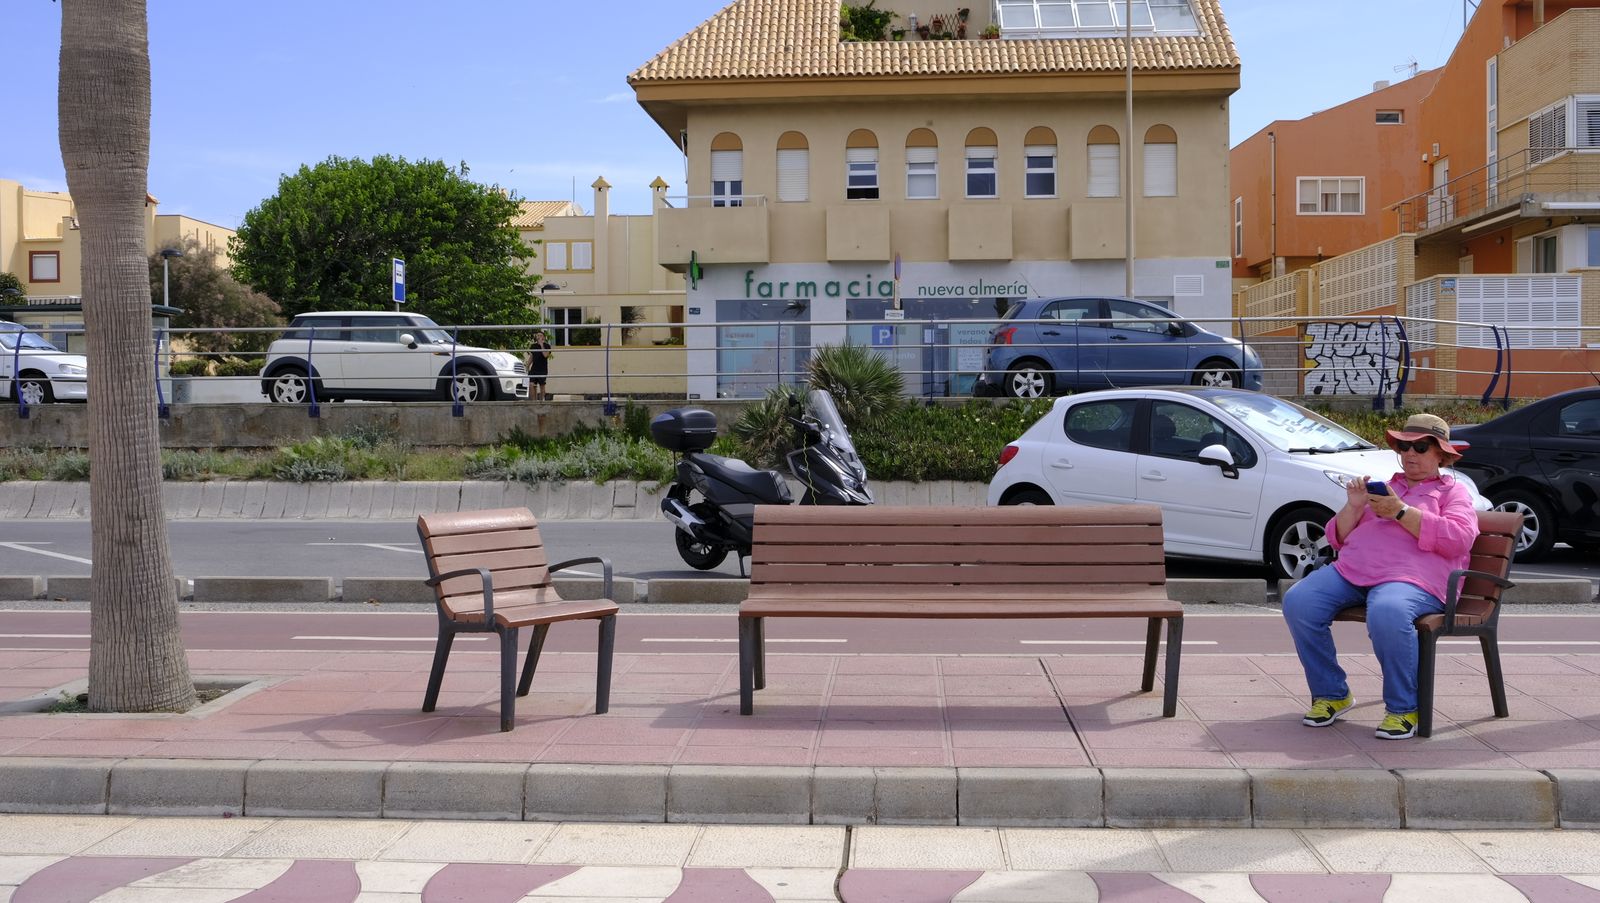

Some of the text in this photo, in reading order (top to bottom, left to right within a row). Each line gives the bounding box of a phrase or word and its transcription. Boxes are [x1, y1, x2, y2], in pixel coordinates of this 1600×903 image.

[745, 270, 894, 298] farmacia
[918, 278, 1028, 296] nueva almería
[879, 329, 891, 344] P
